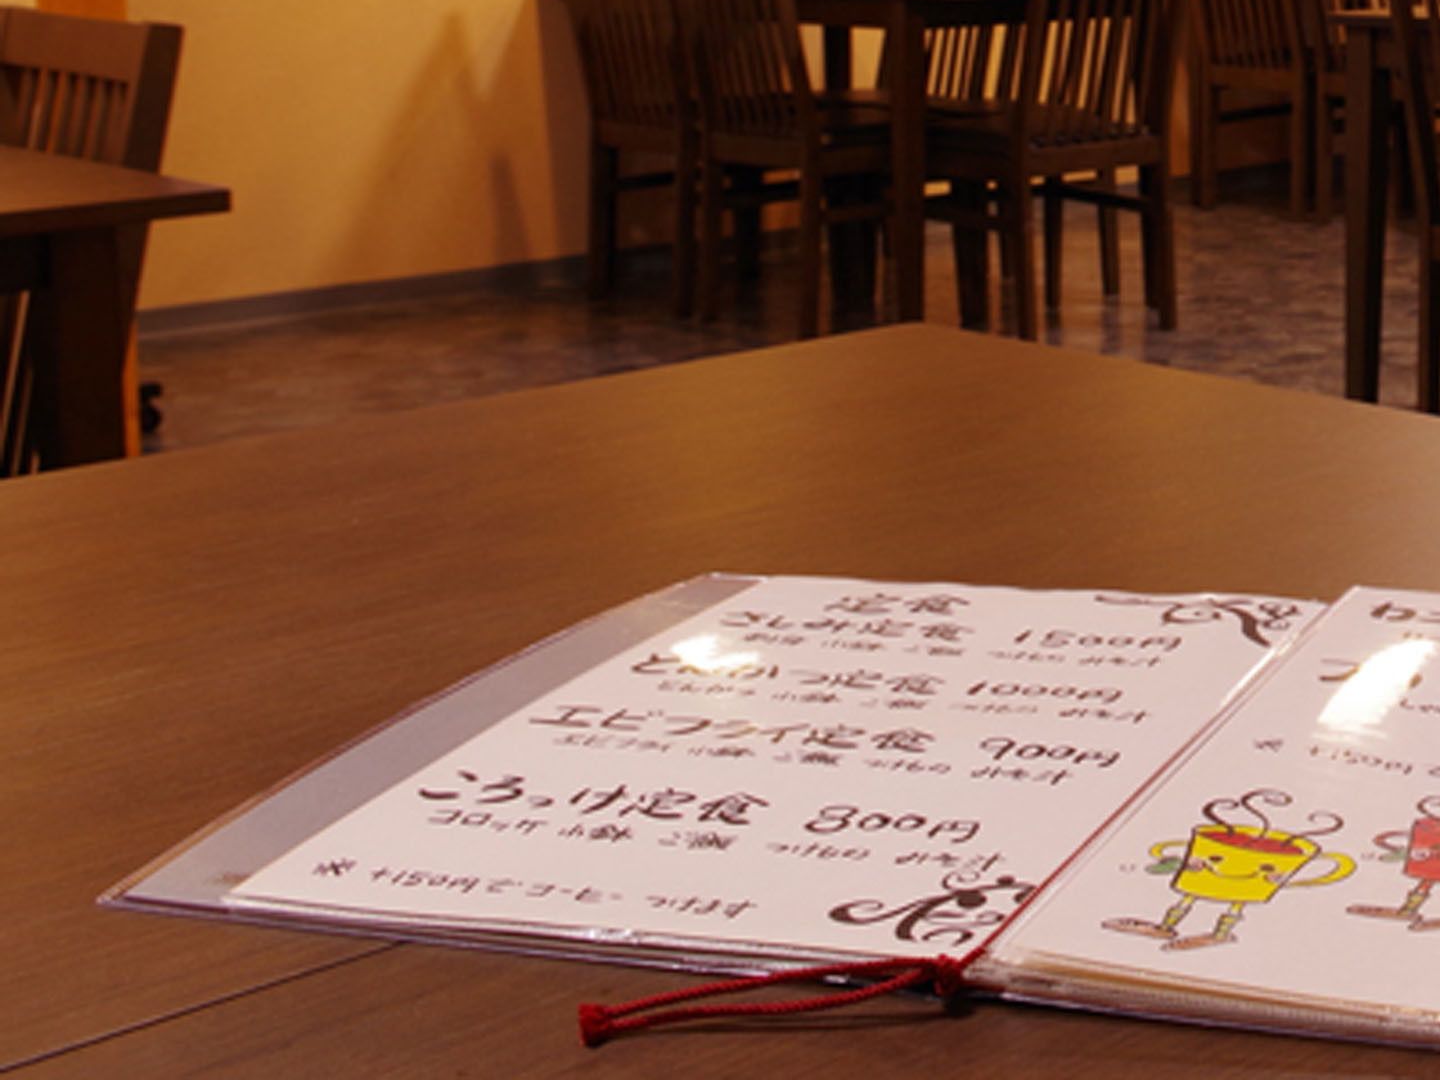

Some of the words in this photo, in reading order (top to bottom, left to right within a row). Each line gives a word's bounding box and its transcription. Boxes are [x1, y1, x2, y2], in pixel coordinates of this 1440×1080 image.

[1014, 630, 1183, 651] 1500円
[966, 681, 1123, 703] 1000円
[529, 705, 935, 752] エビフライ定食
[979, 737, 1119, 768] 900円
[418, 770, 770, 825] ころっけ定食
[802, 805, 981, 843] 800円
